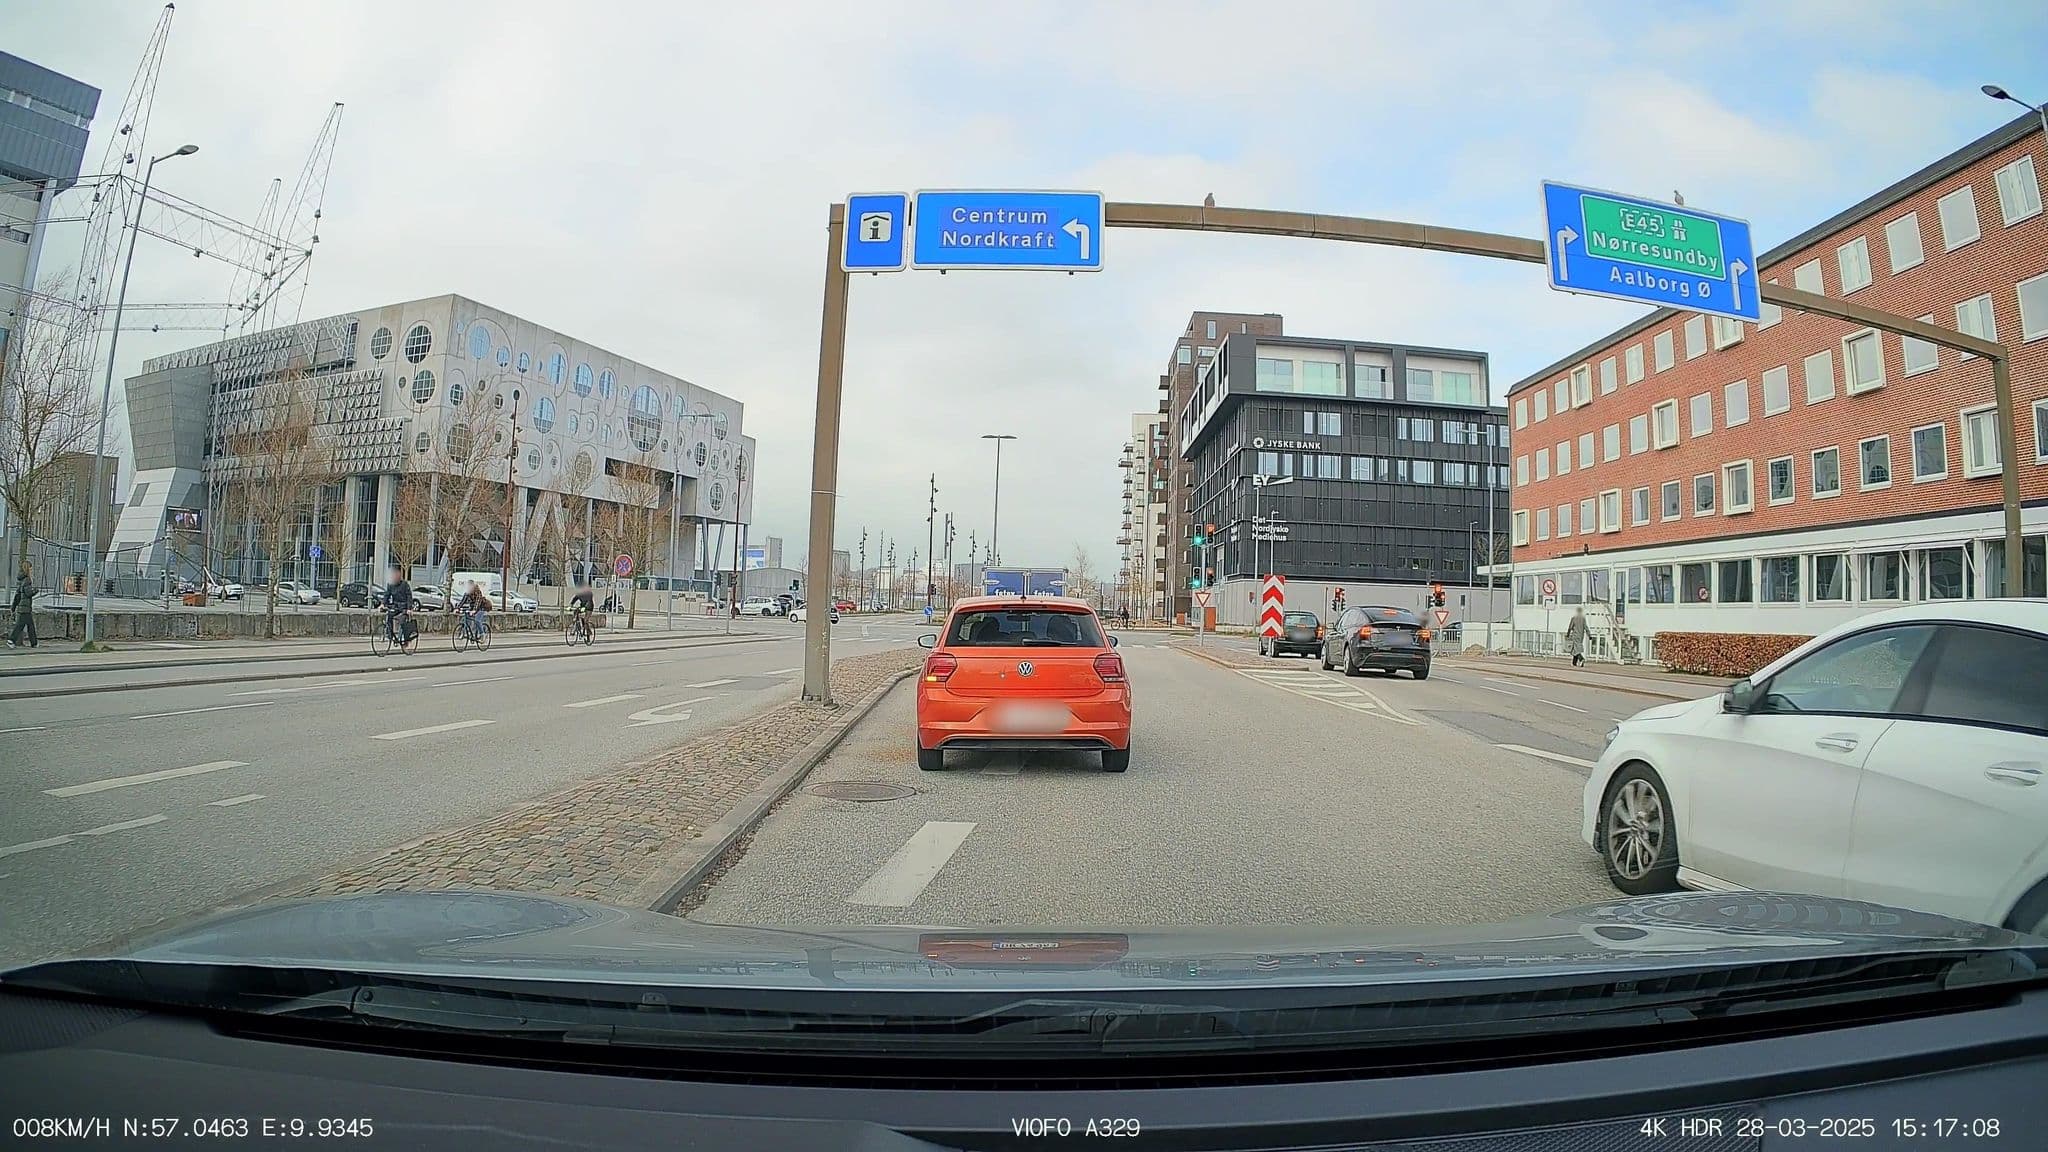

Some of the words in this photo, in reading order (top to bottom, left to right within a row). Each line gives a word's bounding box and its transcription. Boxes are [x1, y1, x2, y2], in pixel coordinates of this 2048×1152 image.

[952, 207, 1047, 223] Centrum
[1625, 213, 1660, 232] E45
[942, 230, 1055, 248] Nordkraft
[1592, 230, 1718, 271] Nørresundby
[1609, 266, 1690, 297] Aalborg
[1697, 281, 1711, 298] Ø
[1267, 439, 1294, 448] JYSKE
[1296, 441, 1321, 450] BANK
[1252, 473, 1270, 486] EY
[1252, 515, 1266, 524] Det
